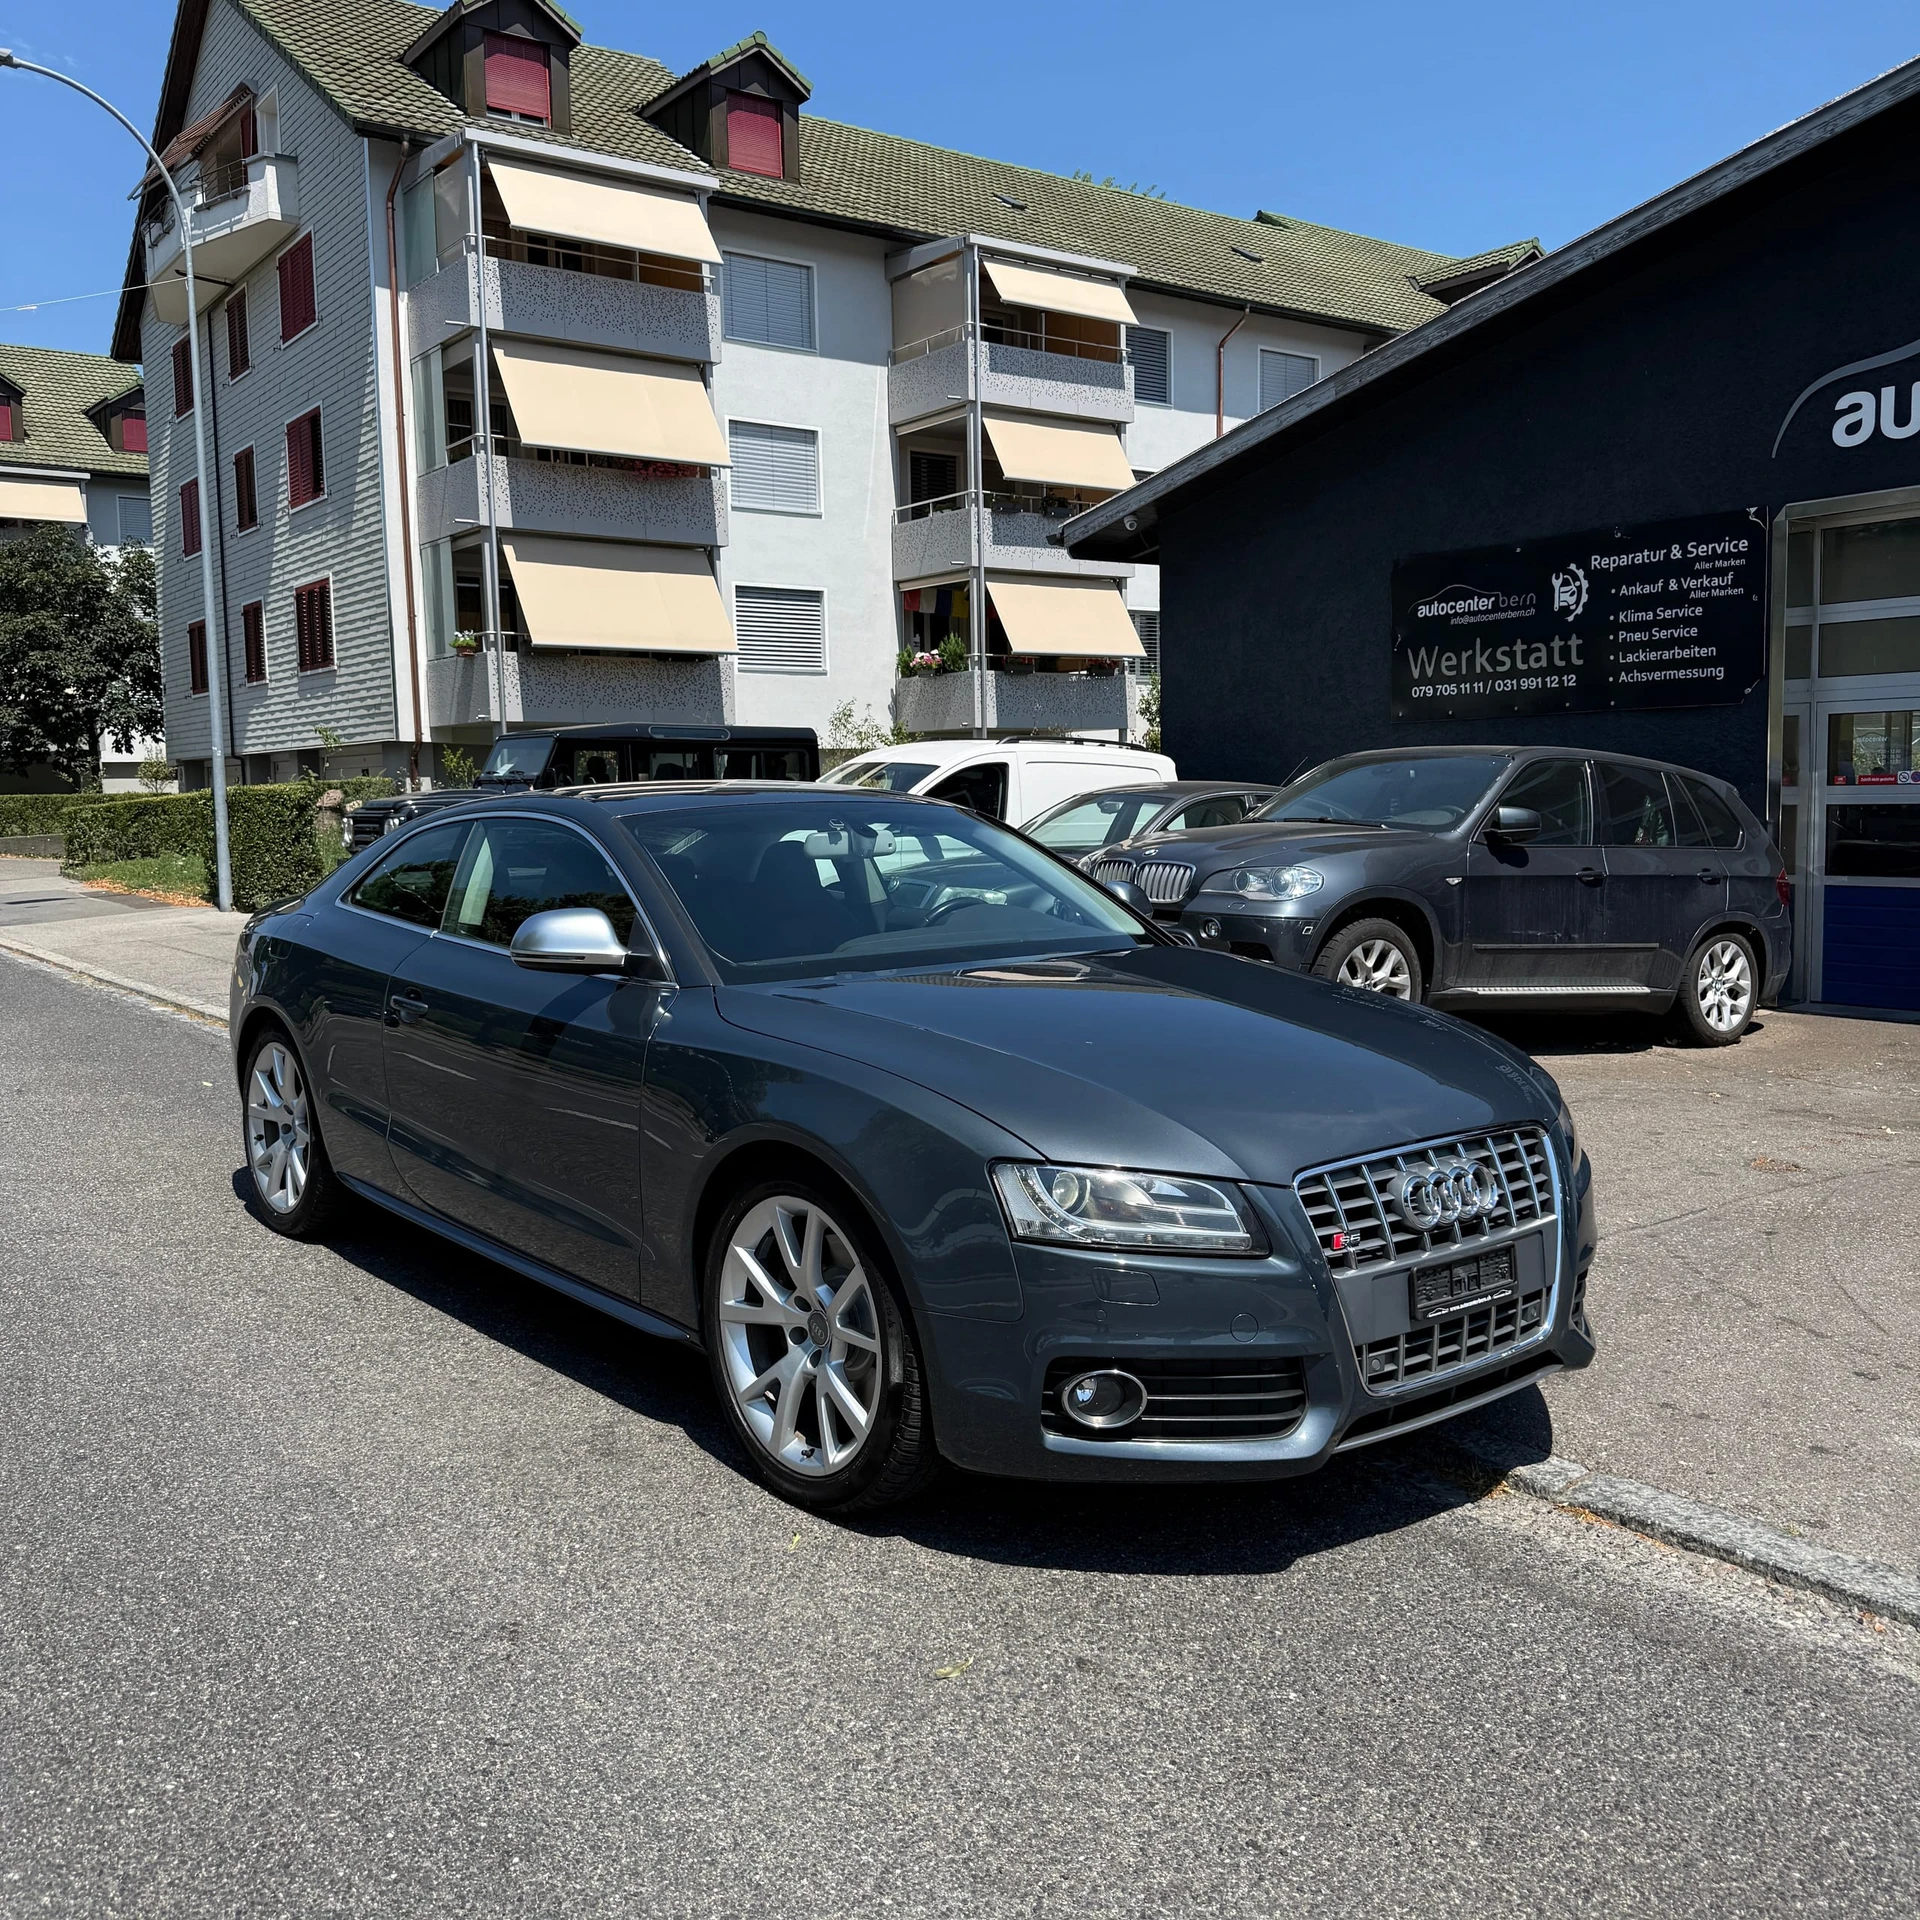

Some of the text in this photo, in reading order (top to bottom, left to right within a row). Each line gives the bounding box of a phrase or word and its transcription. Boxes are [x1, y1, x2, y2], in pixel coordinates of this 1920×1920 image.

[1832, 381, 1920, 448] au
[1591, 537, 1748, 572] Reparatur & Service
[1694, 558, 1746, 570] Aller Marken
[1619, 572, 1734, 597] Ankauf & Verkauf
[1689, 587, 1744, 599] Aller Marken
[1417, 592, 1536, 617] autocenter bern
[1451, 607, 1535, 625] info@autocenterbern.ch
[1619, 605, 1703, 623] Klima Service
[1618, 625, 1698, 643] Pneu Service
[1408, 633, 1583, 679] Werkstatt
[1619, 645, 1716, 663] Lackierarbeiten
[1619, 666, 1724, 683] Achsvermessung
[1412, 674, 1576, 698] 079 705 11 11 / 031 991 12 12
[1339, 1233, 1361, 1247] S5
